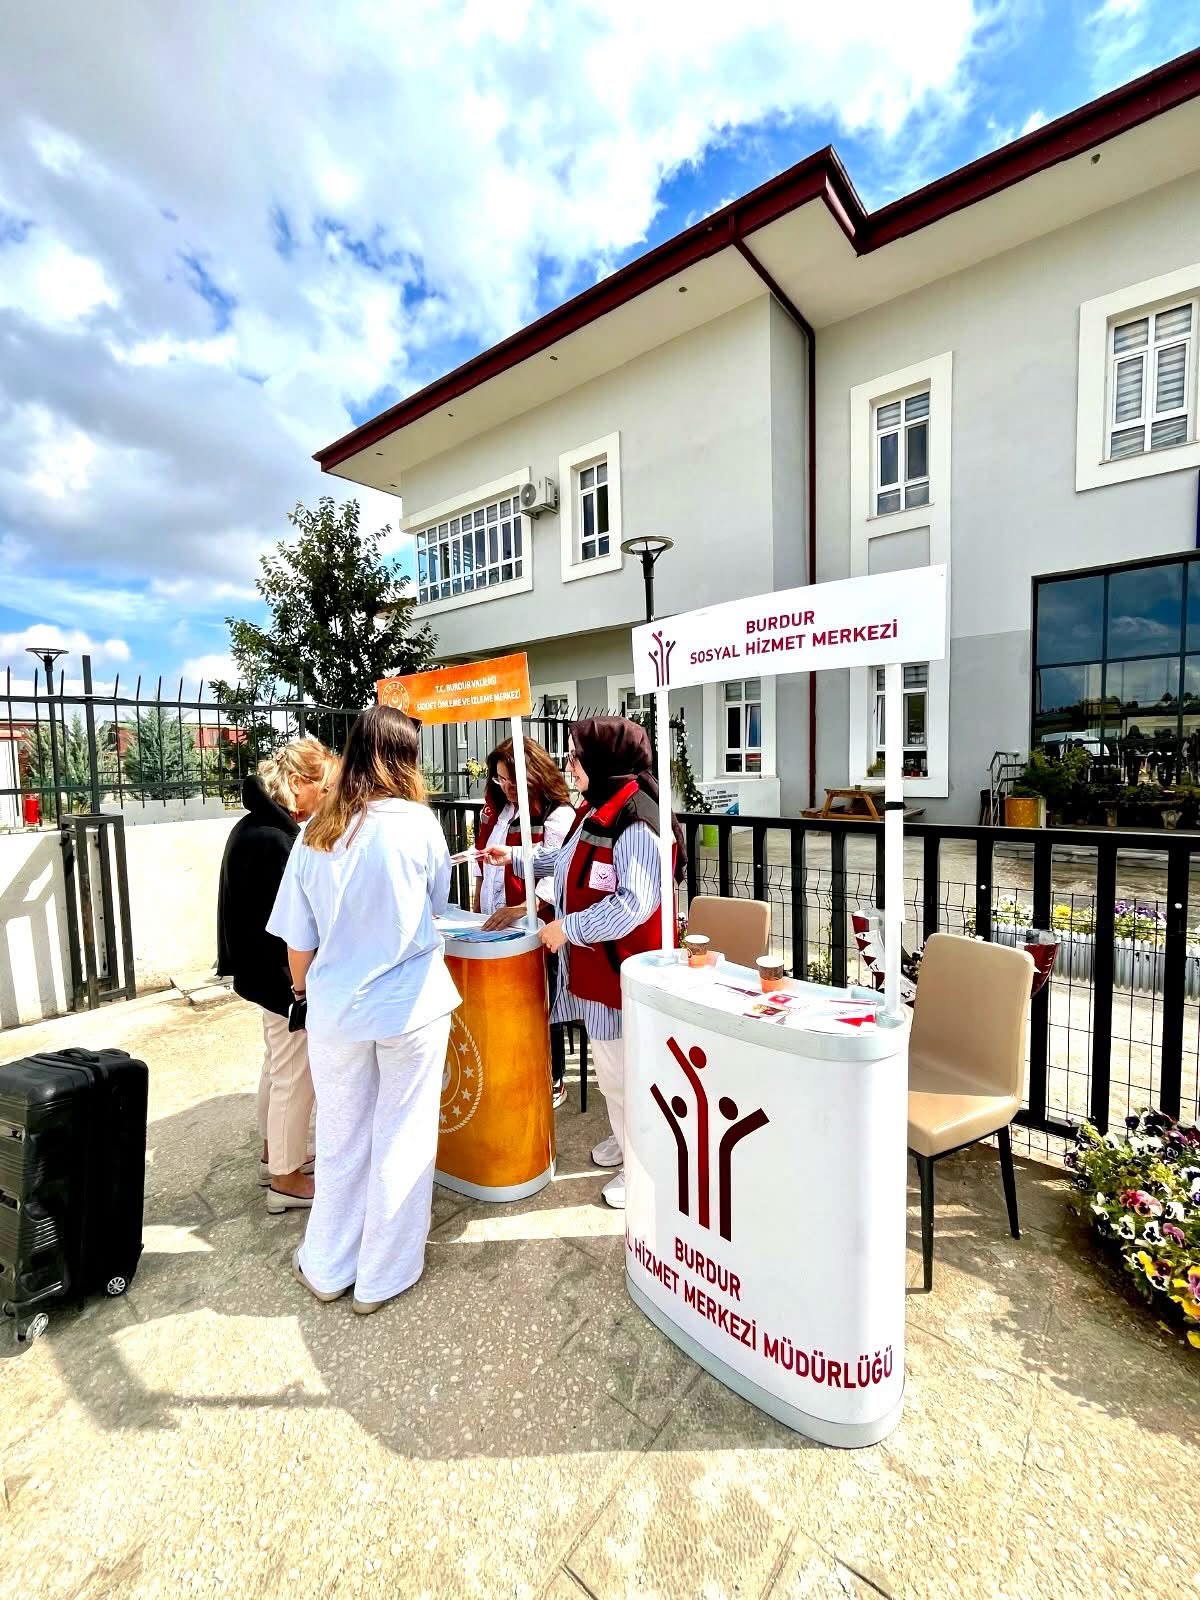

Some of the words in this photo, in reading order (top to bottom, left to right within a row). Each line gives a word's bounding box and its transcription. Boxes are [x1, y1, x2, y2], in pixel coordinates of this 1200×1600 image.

[746, 610, 815, 635] BURDUR
[690, 644, 741, 665] SOSYAL
[745, 634, 806, 656] HİZMET
[812, 619, 898, 647] MERKEZİ
[446, 681, 472, 692] BURDUR
[462, 697, 471, 706] VE
[675, 1236, 741, 1302] BURDUR
[635, 1237, 680, 1295] HİZMET
[684, 1279, 757, 1351] MERKEZİ
[763, 1331, 893, 1389] MÜDÜRLÜĞÜ
